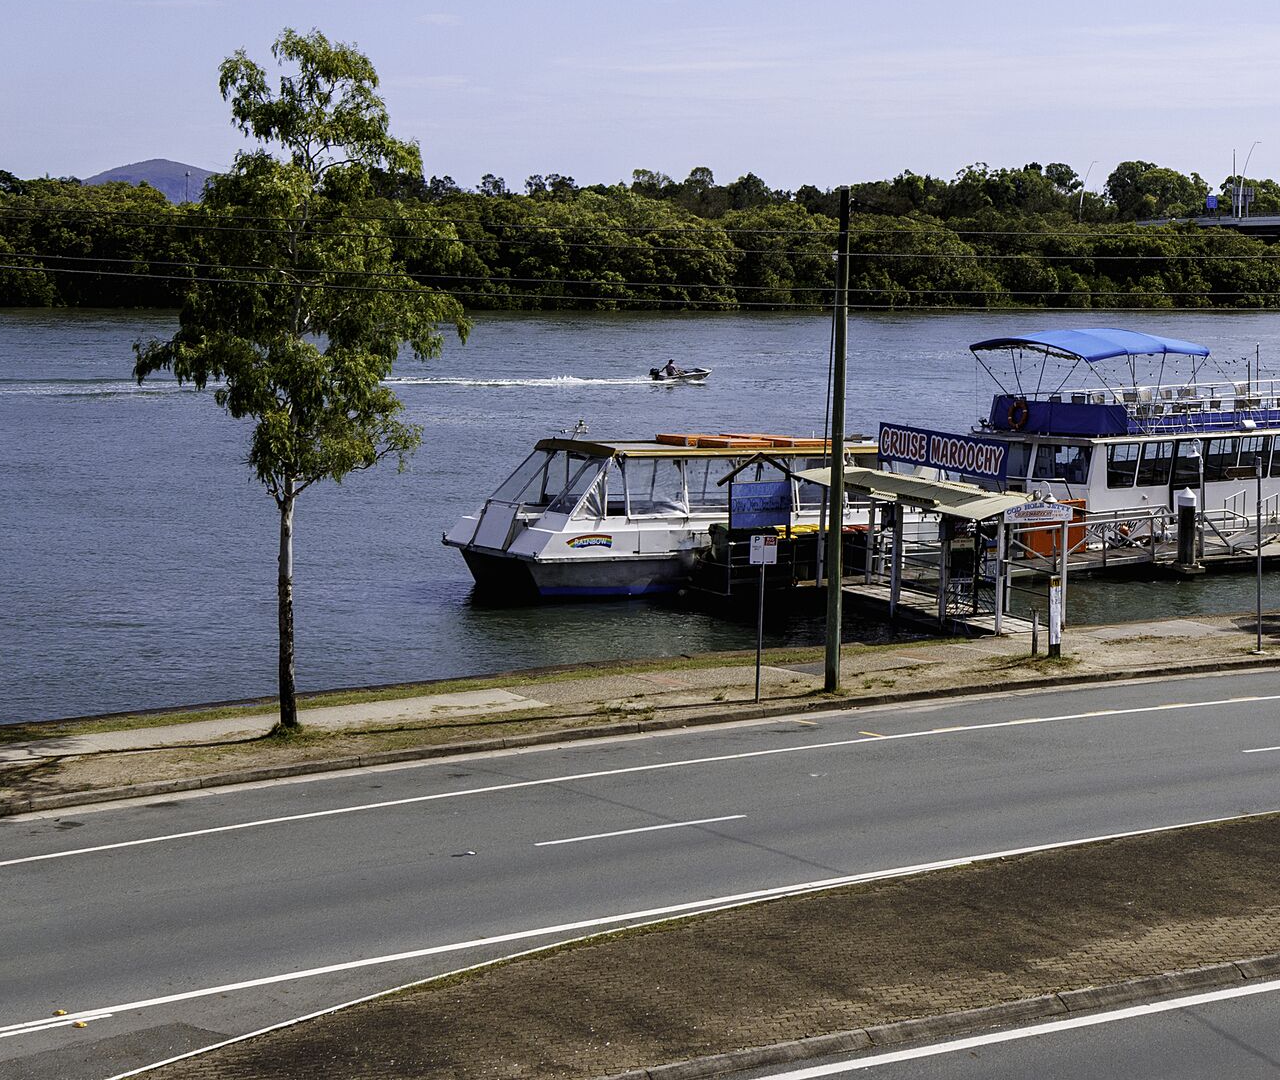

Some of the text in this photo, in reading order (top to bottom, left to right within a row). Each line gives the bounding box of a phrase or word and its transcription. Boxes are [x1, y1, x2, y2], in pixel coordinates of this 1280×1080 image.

[881, 426, 1005, 476] CRUISE MAROOCHY
[1007, 506, 1022, 515] COD
[1024, 502, 1045, 511] HOLE
[1047, 503, 1071, 512] JETTY
[574, 538, 607, 546] RAINBOW
